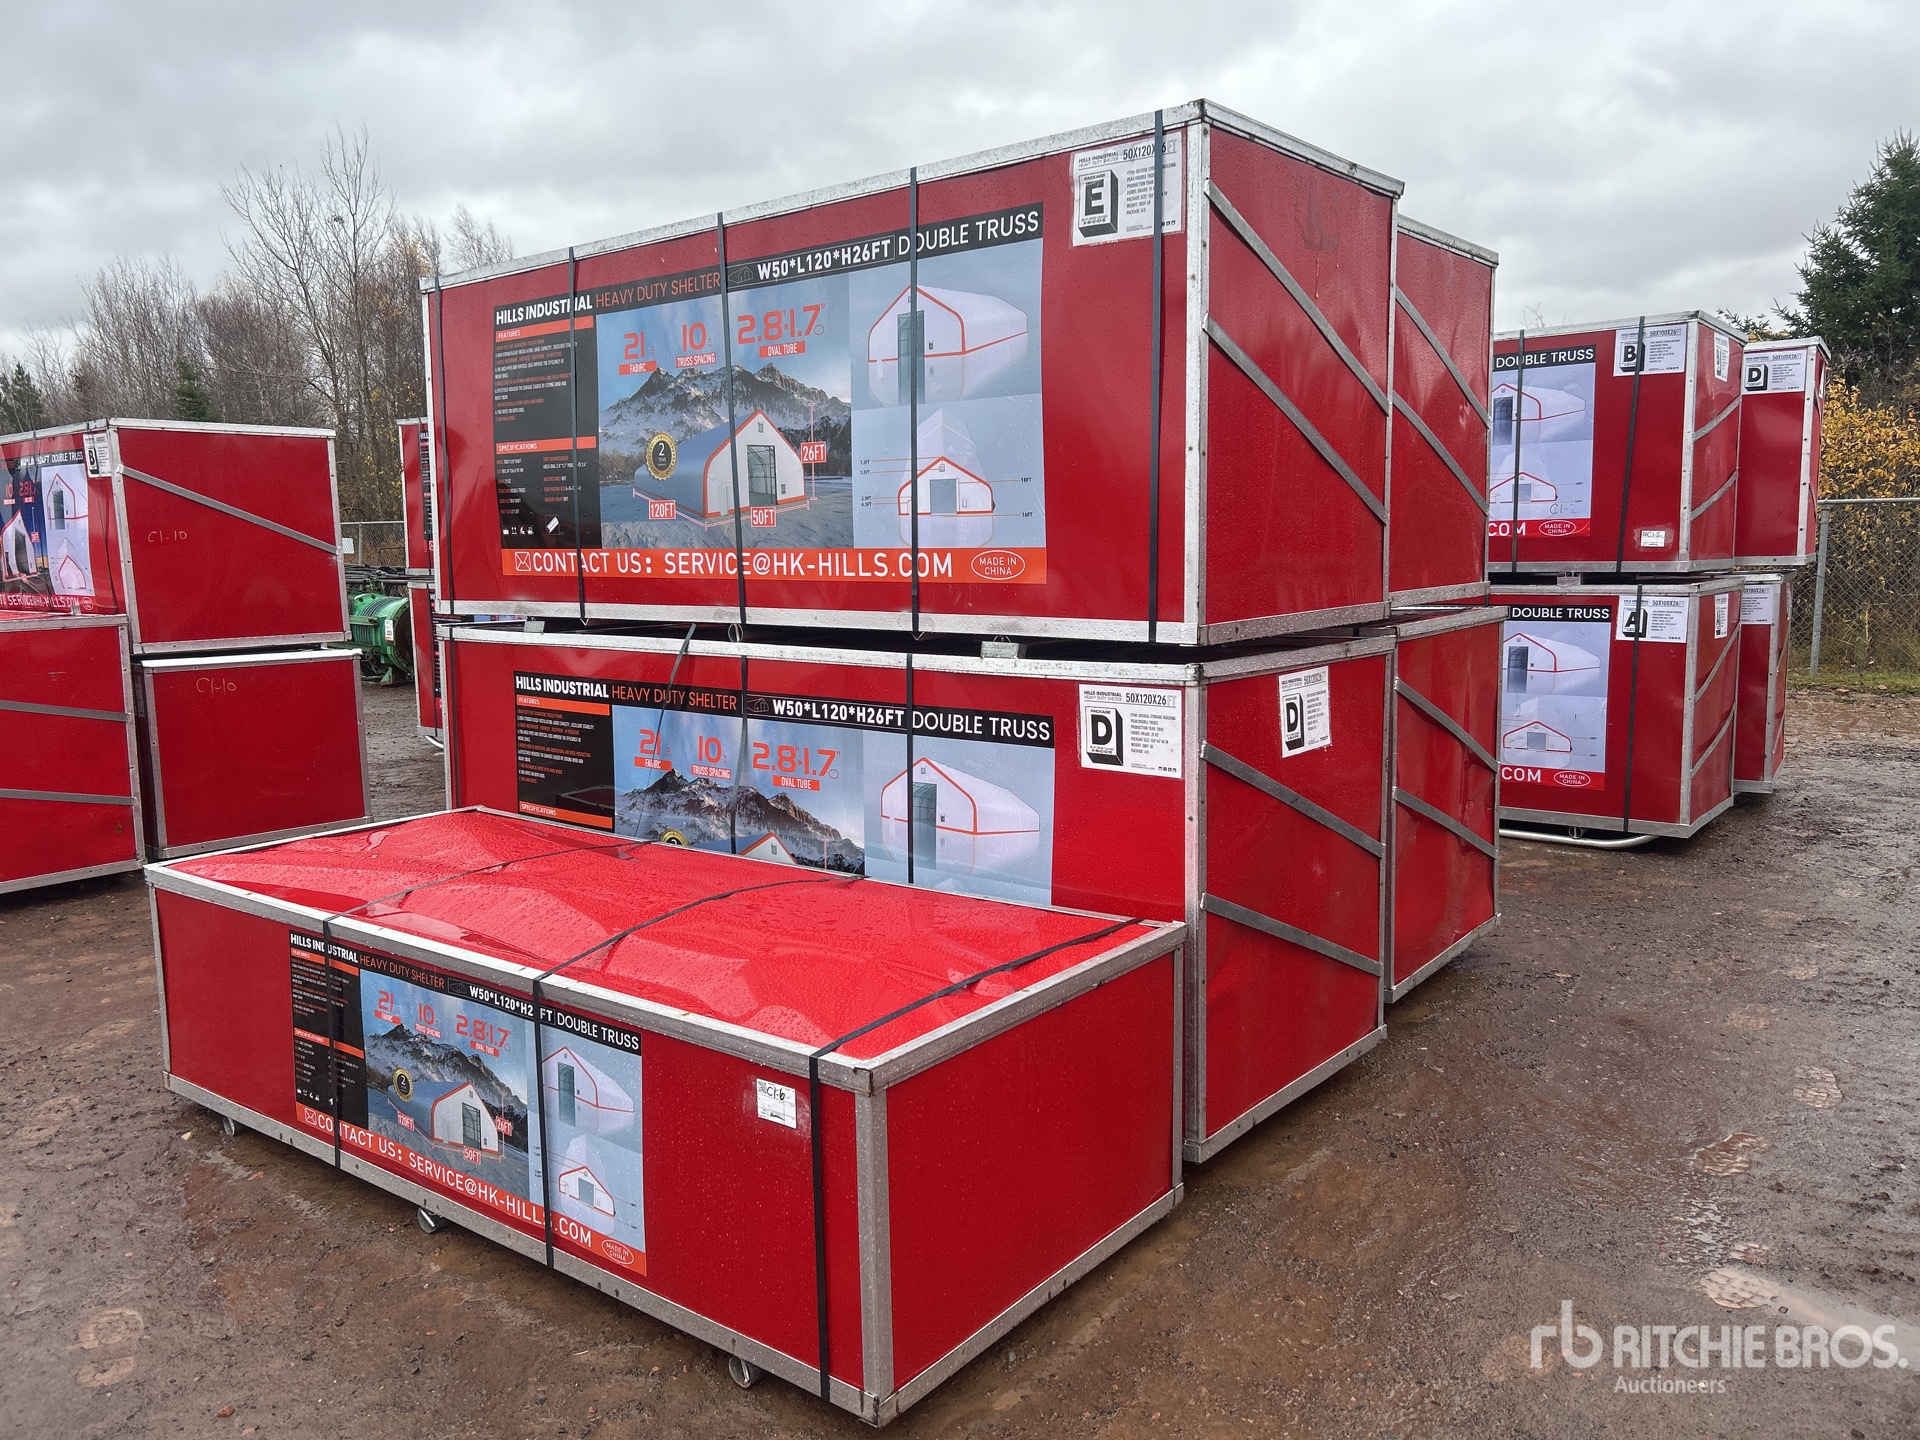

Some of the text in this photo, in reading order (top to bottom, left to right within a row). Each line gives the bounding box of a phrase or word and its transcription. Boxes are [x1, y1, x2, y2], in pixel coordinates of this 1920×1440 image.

[1084, 178, 1104, 216] E
[496, 308, 524, 325] HILLS
[595, 288, 634, 308] HEAVY
[637, 282, 668, 300] DUTY
[671, 272, 720, 296] SHELTER
[898, 224, 969, 256] DOUBLE
[975, 210, 1039, 241] TRUSS
[498, 330, 520, 339] FEATURES
[624, 331, 644, 360] 21
[682, 322, 706, 352] 10
[676, 356, 693, 367] TRUSS
[693, 354, 716, 366] SPACING
[767, 345, 782, 357] OVAL
[782, 342, 798, 355] TUBE
[1496, 348, 1594, 368] DOUBLE TRUSS
[1624, 345, 1637, 362] B
[1748, 368, 1761, 382] D
[498, 443, 537, 452] SPECIFICATIONS
[659, 442, 665, 456] 2
[802, 444, 825, 461] 26FT
[650, 502, 674, 517] 120FT
[752, 509, 774, 525] 50FT
[533, 552, 953, 578] CONTACT US: SERVICE@HK-HILLS.COM
[979, 557, 1017, 566] MADE IN
[984, 566, 1012, 576] CHINA
[1512, 607, 1610, 619] DOUBLE TRUSS
[515, 676, 542, 692] HILLS
[543, 679, 609, 698] INDUSTRIAL
[611, 685, 650, 702] HEAVY
[654, 689, 686, 705] DUTY
[688, 691, 737, 710] SHELTER
[912, 710, 983, 735] DOUBLE
[989, 717, 1050, 740] TRUSS
[519, 696, 540, 705] FEATURES
[1286, 702, 1298, 732] D
[1091, 714, 1112, 746] D
[639, 728, 661, 756] 21
[697, 735, 722, 764] 10
[692, 765, 709, 777] TRUSS
[709, 767, 730, 779] SPACING
[781, 777, 796, 788] OVAL
[797, 778, 811, 790] TUBE
[1501, 767, 1541, 783] COM
[522, 803, 557, 816] SPECIFICATIONS
[290, 934, 311, 948] HILLS
[360, 955, 388, 971] HEAVY
[390, 963, 410, 978] DUTY
[412, 969, 445, 989] SHELTER
[469, 986, 553, 1022] W50L120H2FT
[557, 1013, 598, 1038] DOUBLE
[600, 1027, 639, 1050] TRUSS
[378, 990, 394, 1013] 21
[418, 1002, 435, 1025] 10
[400, 1076, 406, 1085] 2
[497, 1118, 512, 1134] 26FT
[378, 1137, 402, 1161] US:
[464, 1148, 480, 1164] 50FT
[606, 1242, 629, 1256] MADE IN
[609, 1250, 626, 1261] CHINA
